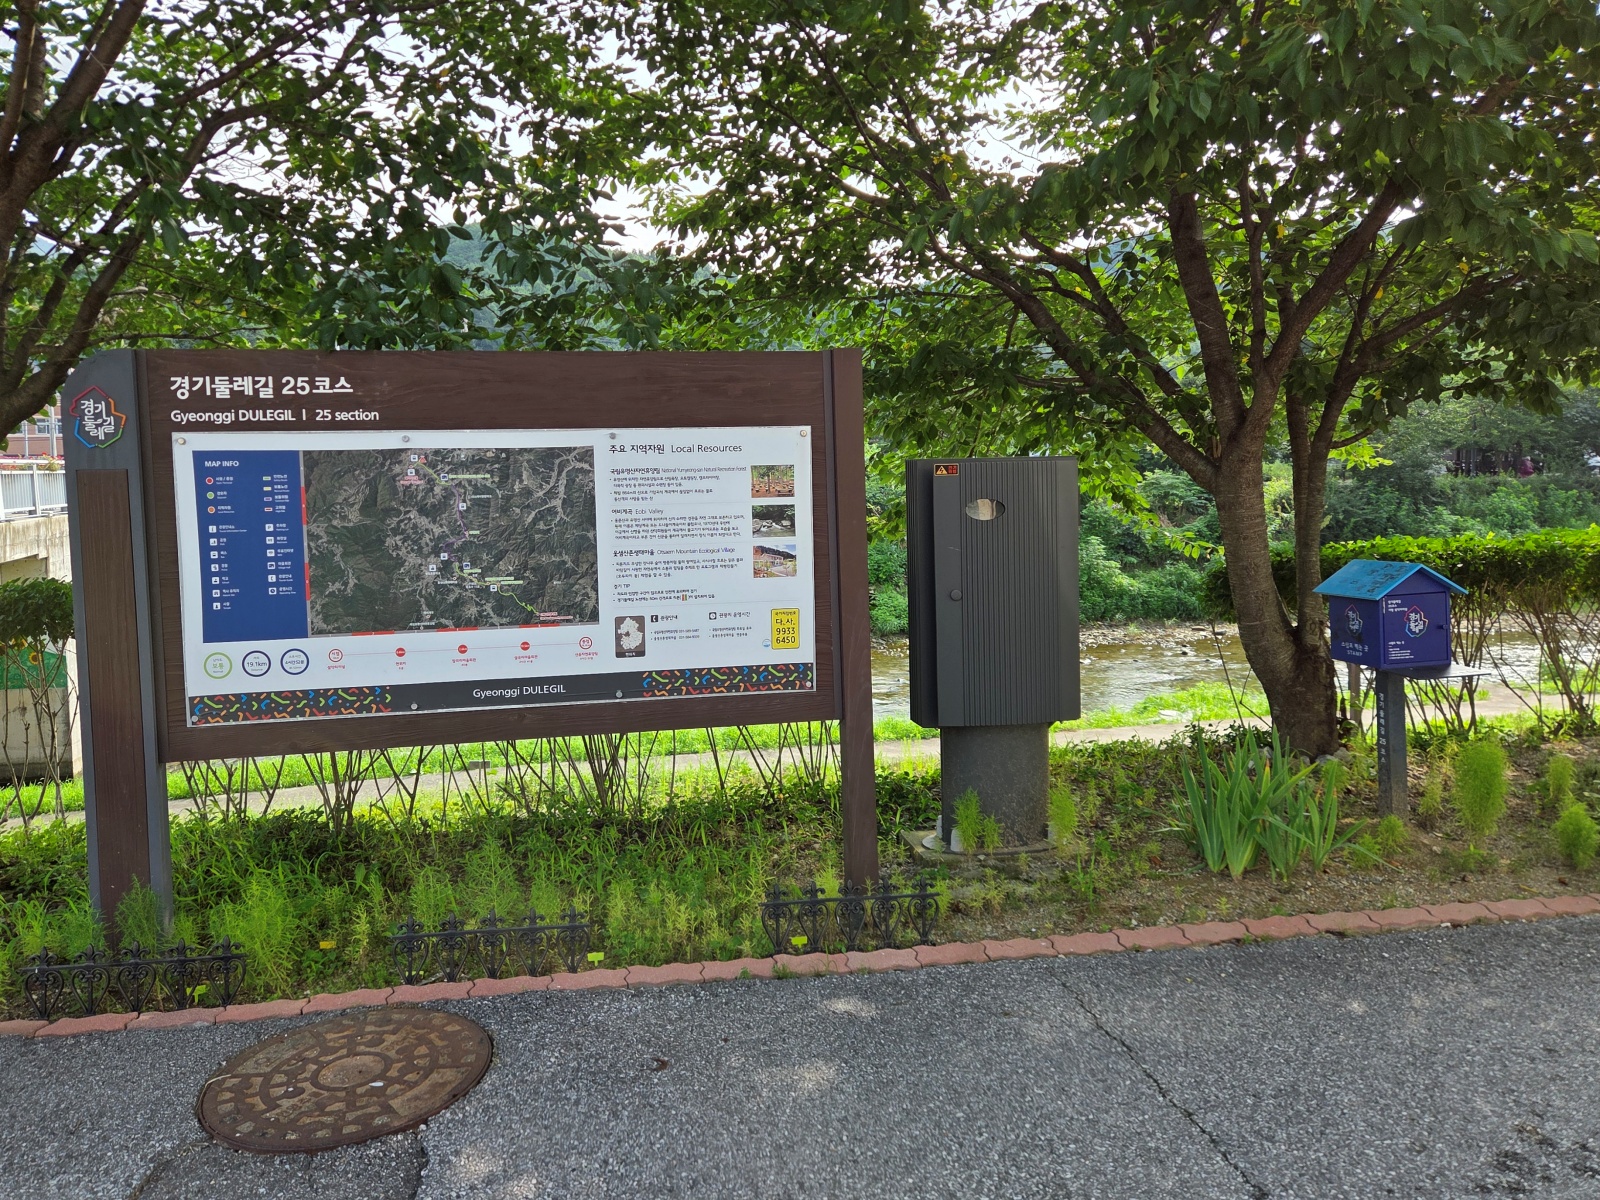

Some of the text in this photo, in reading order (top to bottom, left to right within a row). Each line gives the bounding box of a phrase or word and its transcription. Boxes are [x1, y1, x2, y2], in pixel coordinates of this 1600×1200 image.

[170, 376, 274, 399] 경기둘레길
[80, 398, 106, 418] 경기
[170, 409, 236, 424] Gyeonggi
[238, 409, 296, 422] DULEGIL
[315, 410, 332, 421] 25
[335, 409, 380, 421] section
[609, 444, 742, 454] 주요 지역자원 Local Resources
[776, 636, 795, 644] 6450
[473, 684, 566, 699] Gyeonggi DULEGIL
